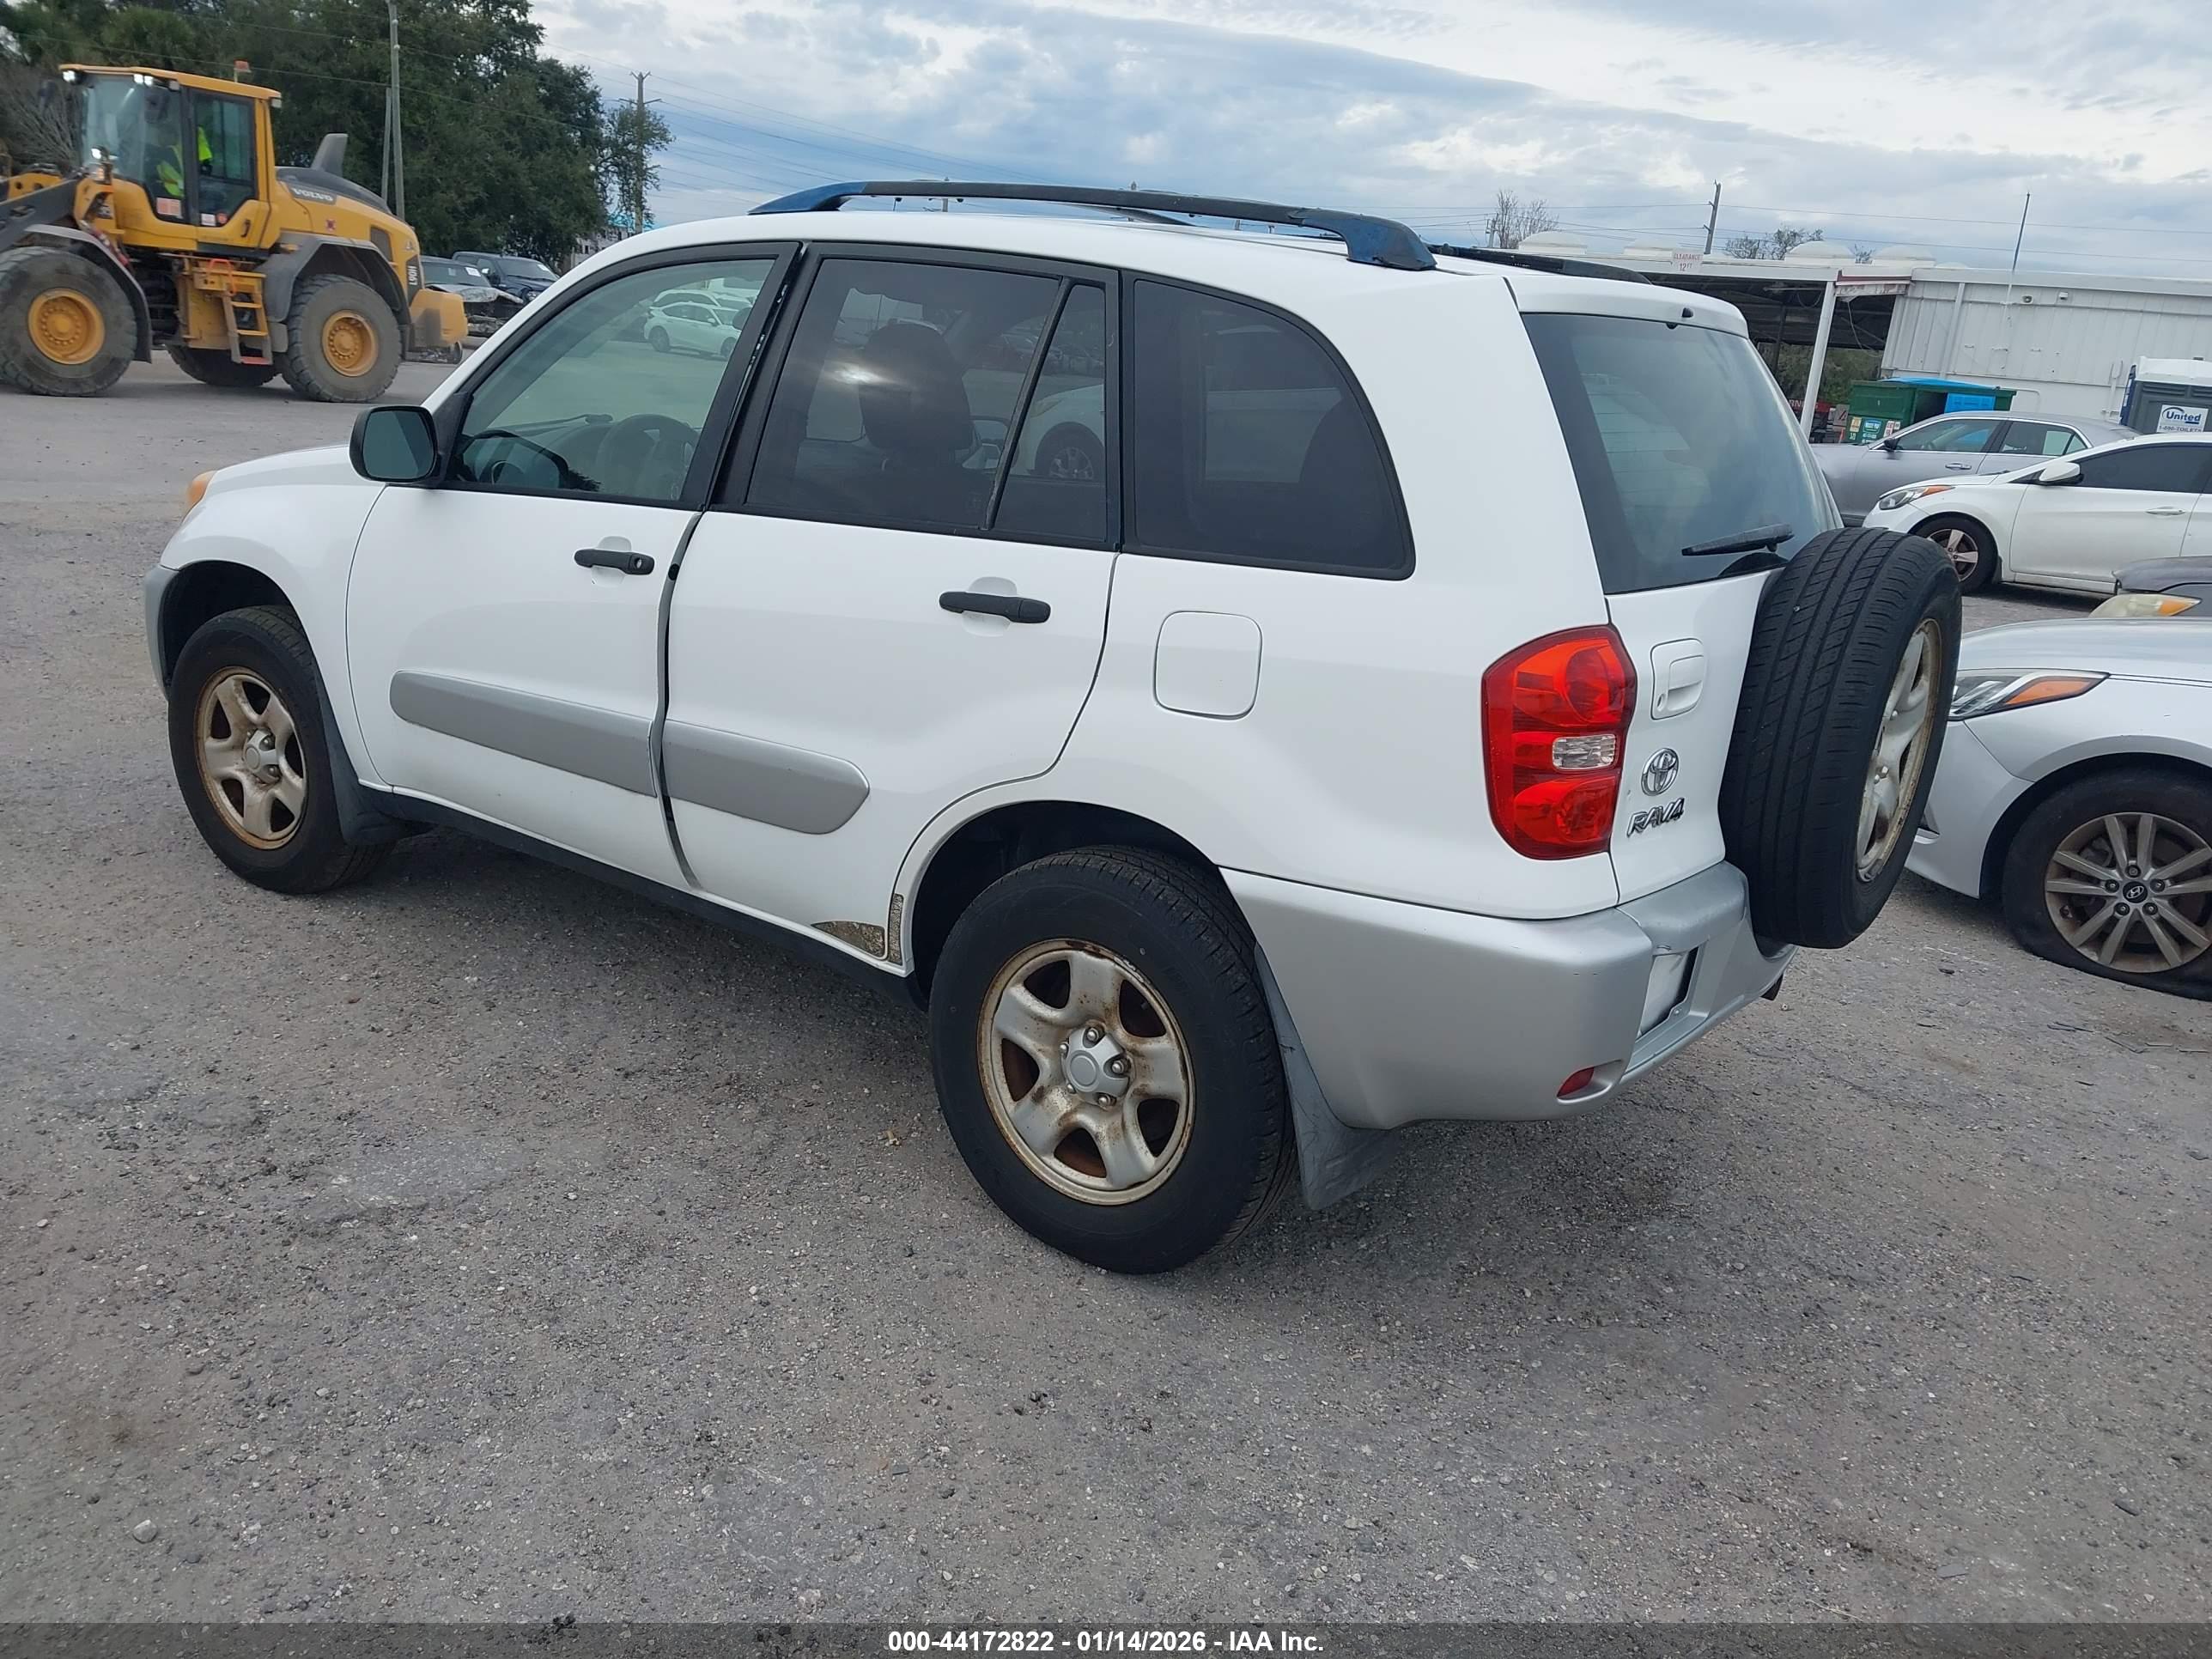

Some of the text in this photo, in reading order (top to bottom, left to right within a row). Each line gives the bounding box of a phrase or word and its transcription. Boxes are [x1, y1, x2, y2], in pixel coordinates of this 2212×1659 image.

[407, 265, 418, 286] L90H
[2166, 410, 2202, 422] United
[1626, 797, 1685, 838] RAV4
